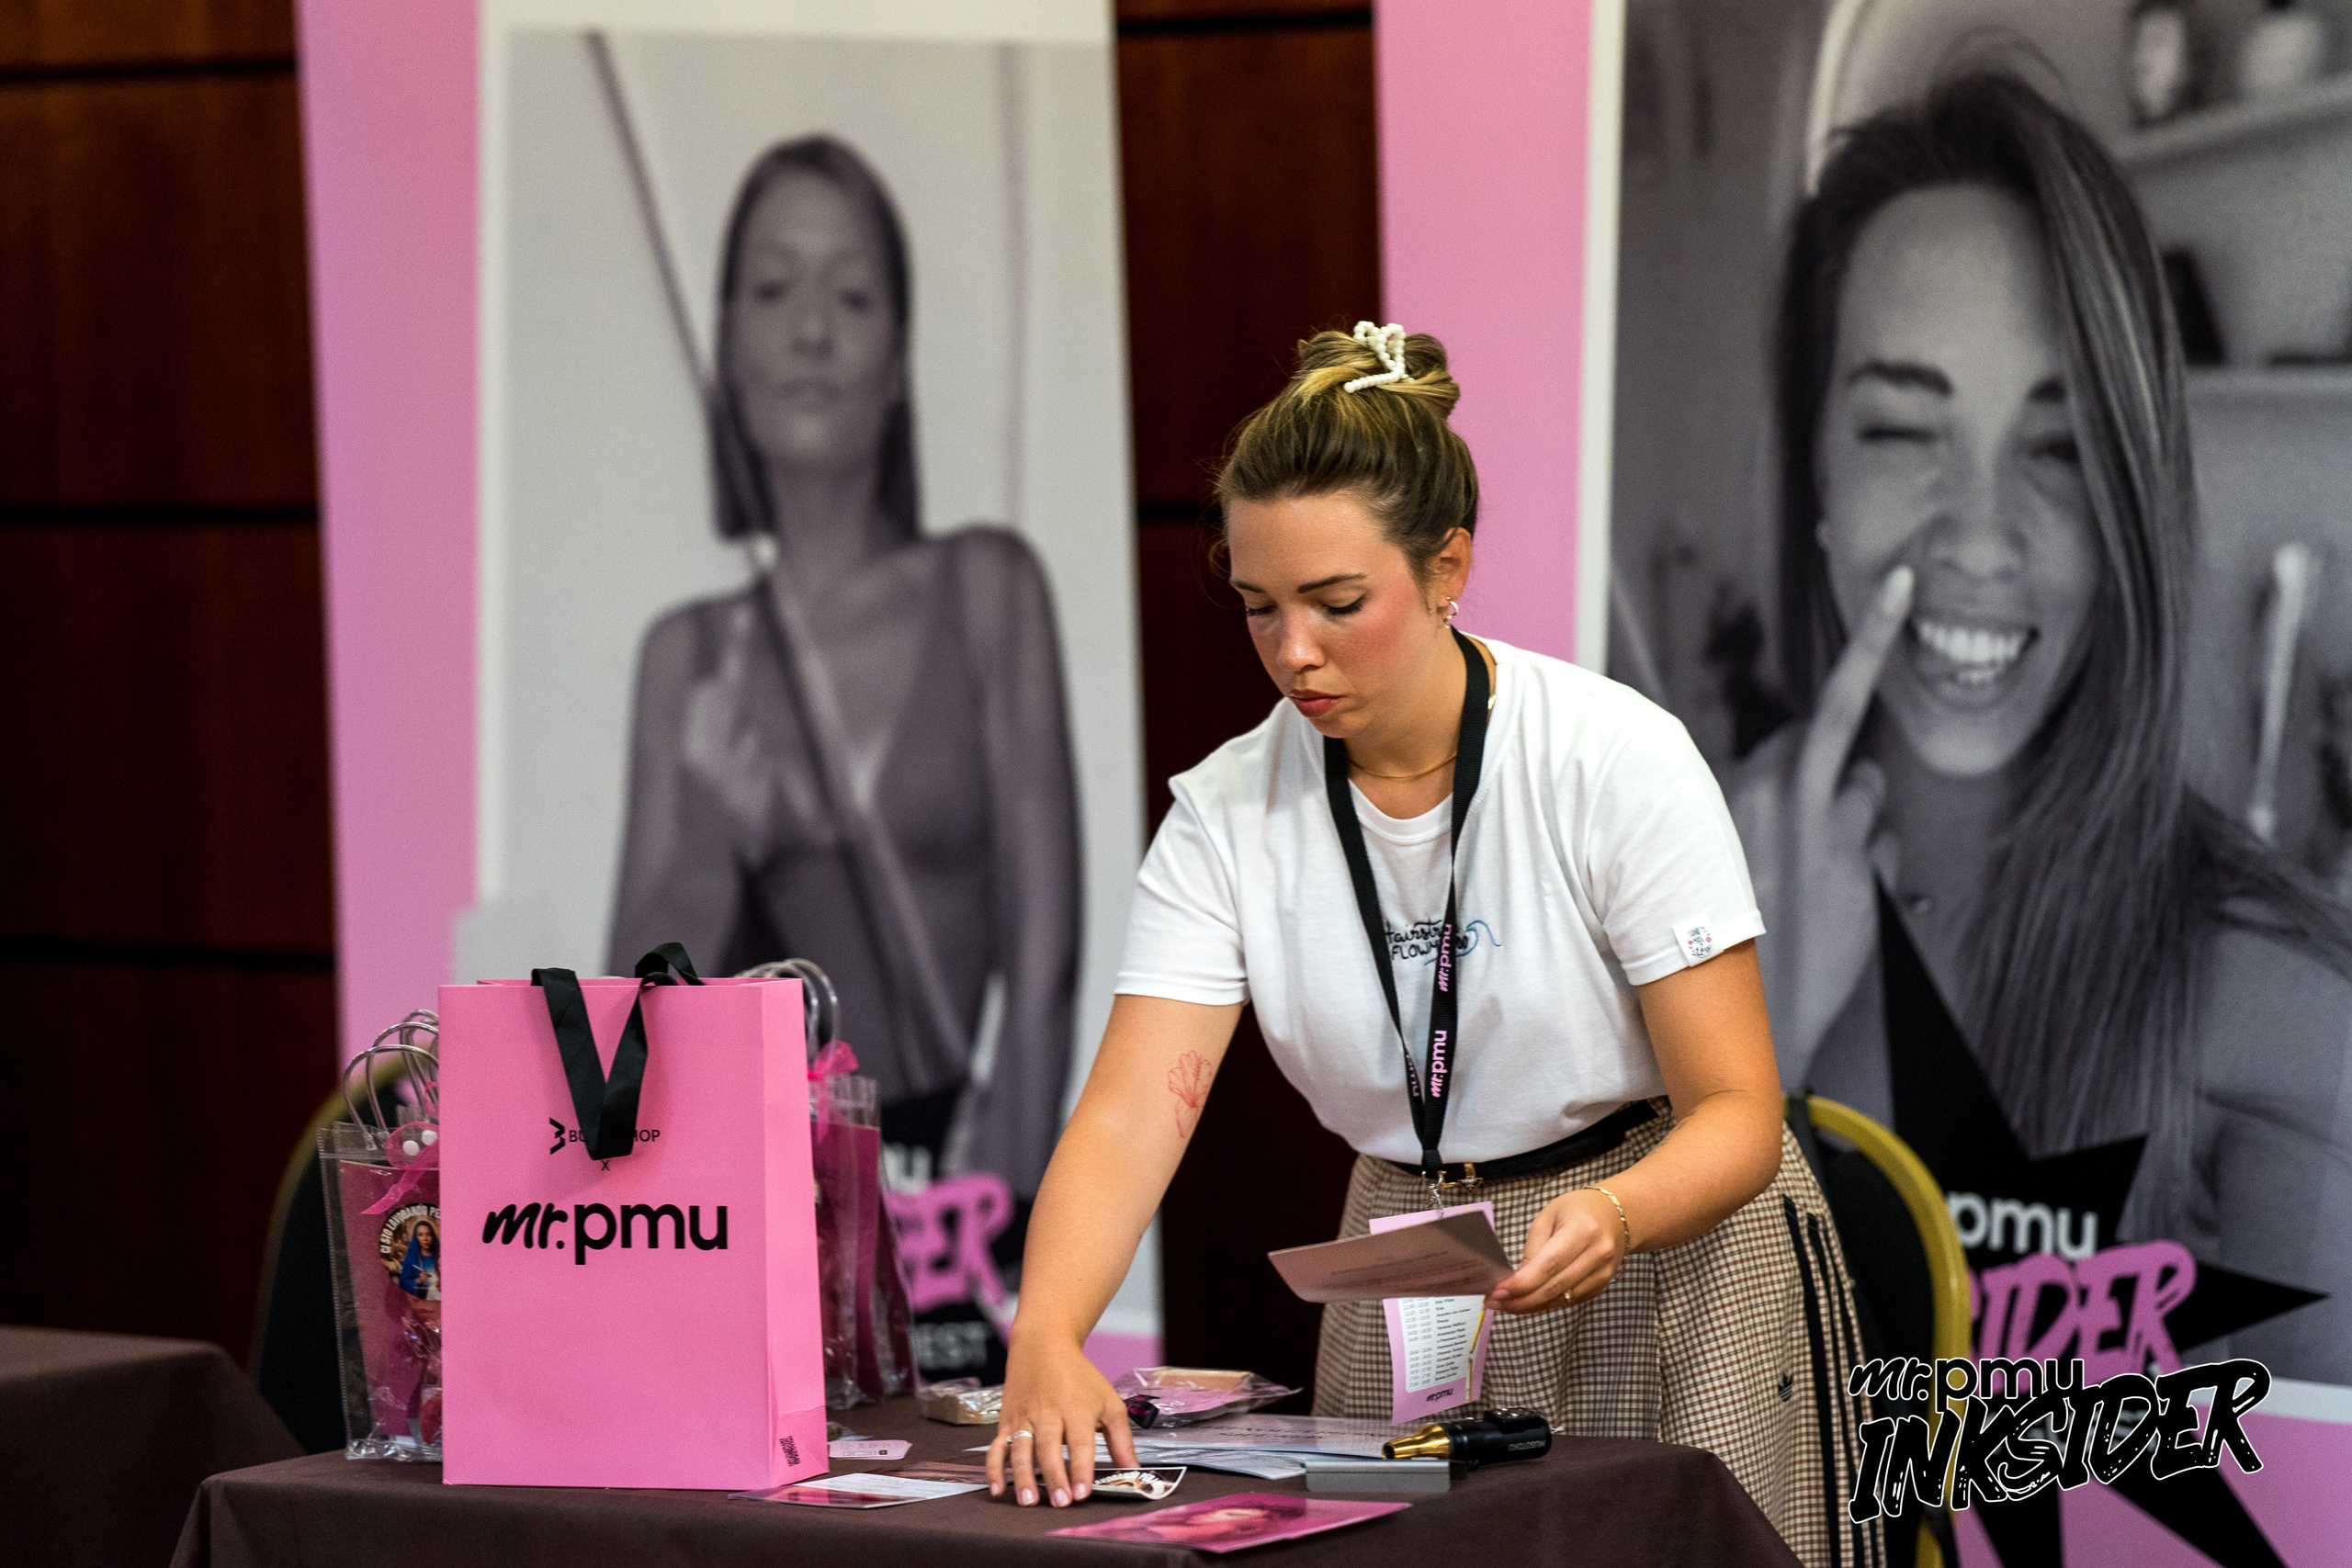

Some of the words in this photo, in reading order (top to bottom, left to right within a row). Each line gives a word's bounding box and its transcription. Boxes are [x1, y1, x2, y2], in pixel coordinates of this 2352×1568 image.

[1438, 923, 1453, 992] mr.pmu
[1430, 1030, 1448, 1098] mr.pmu
[379, 1228, 394, 1245] STO
[482, 1201, 729, 1266] mr.pmu
